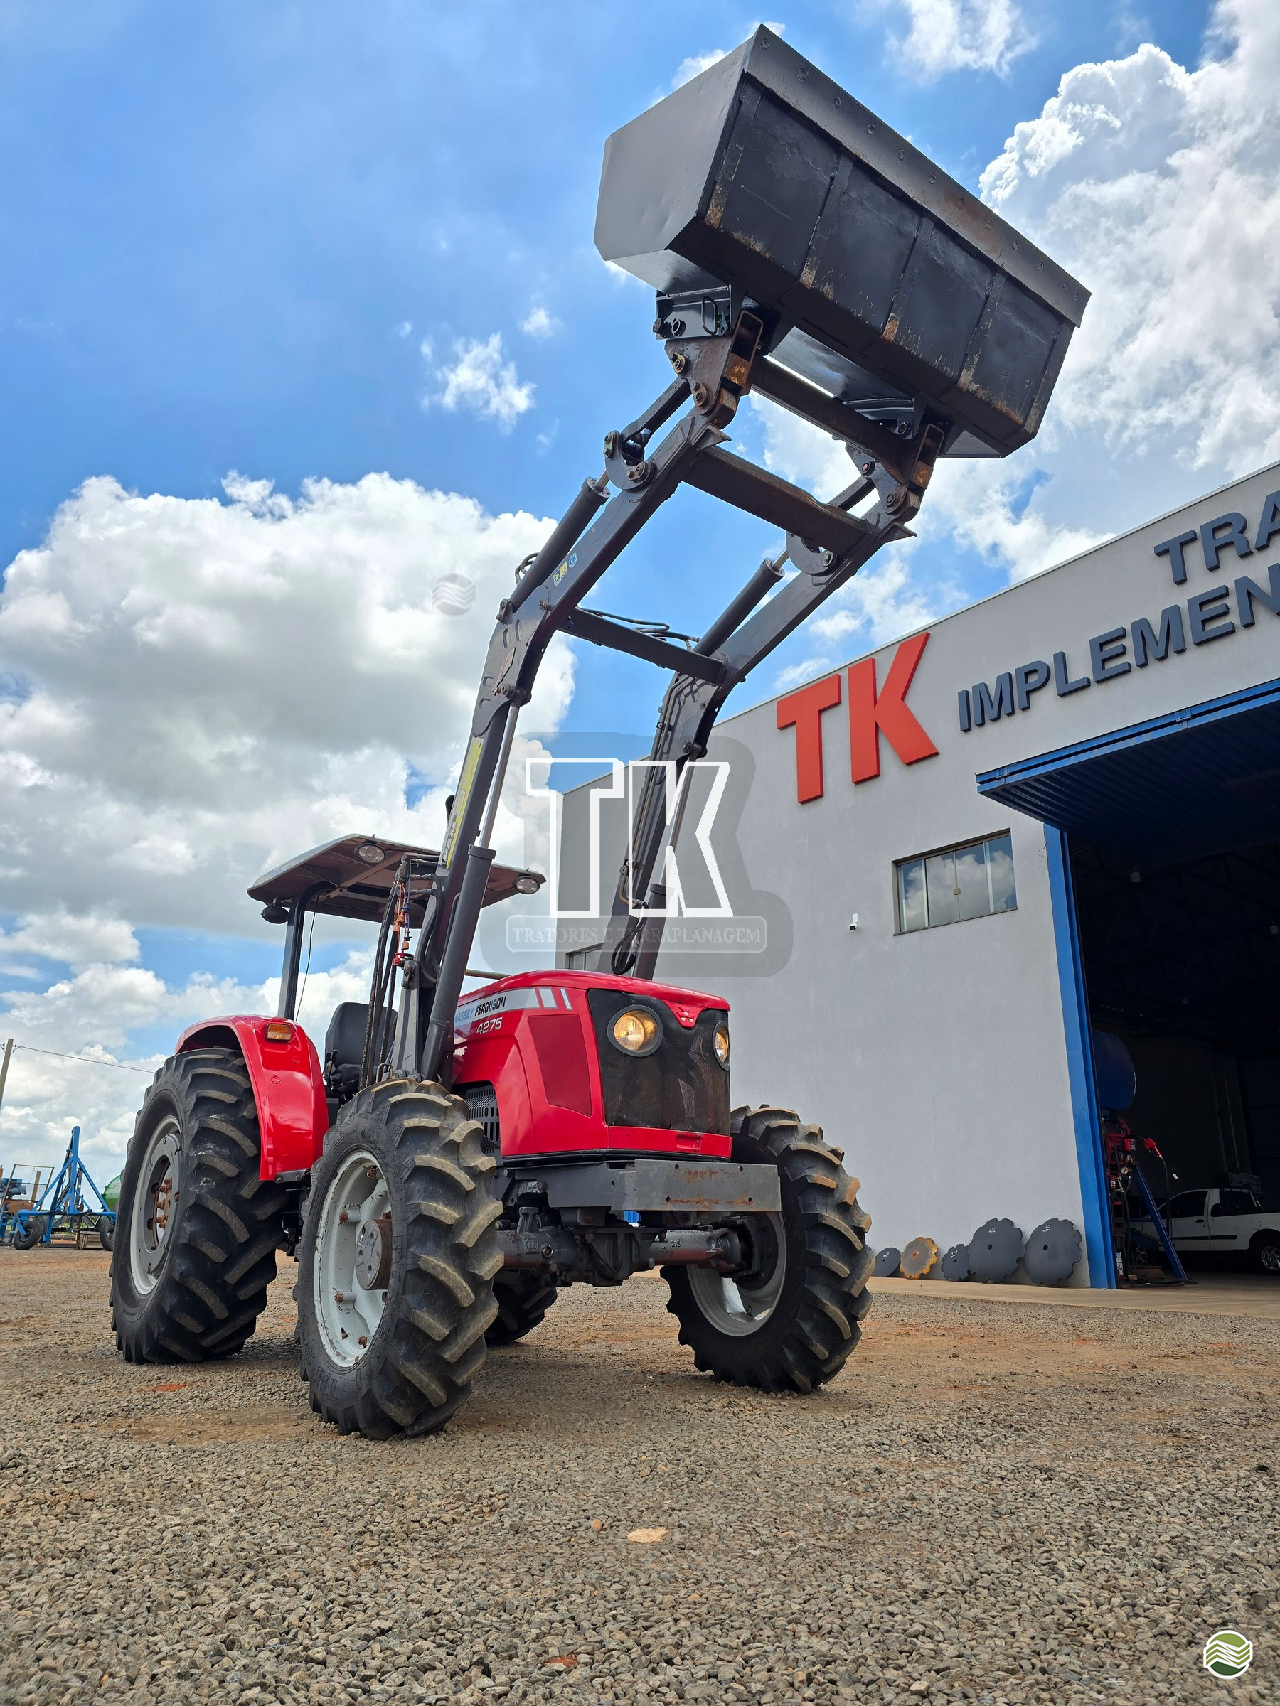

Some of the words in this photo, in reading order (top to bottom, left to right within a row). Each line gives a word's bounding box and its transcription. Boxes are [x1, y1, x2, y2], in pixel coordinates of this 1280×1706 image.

[777, 632, 940, 804] TK
[958, 562, 1280, 732] IMPLEMEN
[476, 1017, 503, 1034] 4275
